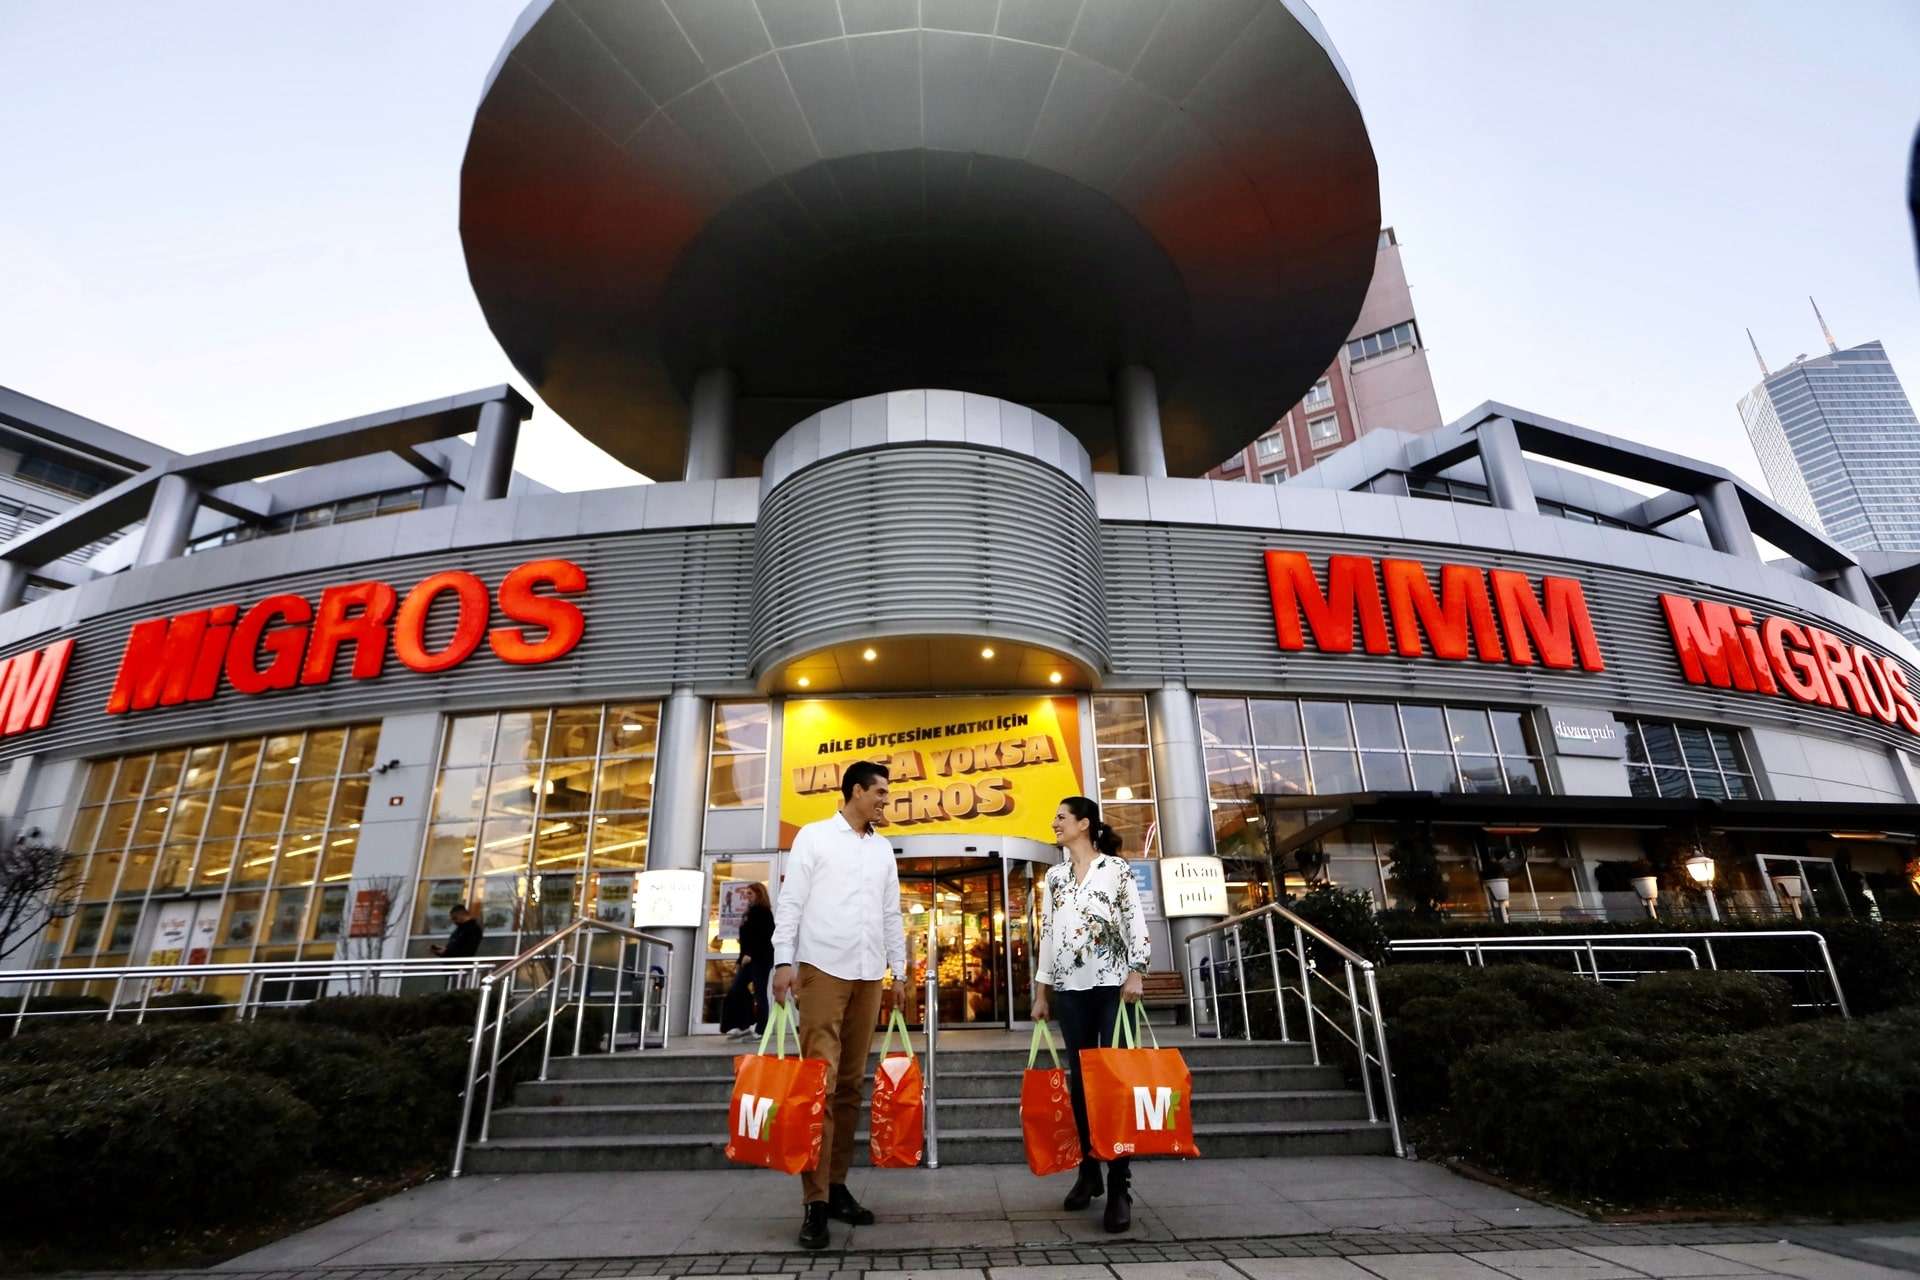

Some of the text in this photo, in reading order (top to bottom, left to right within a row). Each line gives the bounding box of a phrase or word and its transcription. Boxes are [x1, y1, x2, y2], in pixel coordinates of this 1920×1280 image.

[1264, 550, 1605, 672] MMM
[817, 713, 1028, 755] AİLE BÜTÇESİNE KATKI İÇİN
[1555, 720, 1616, 743] divan pub
[930, 735, 1059, 777] YOKSA
[1174, 863, 1218, 878] divan
